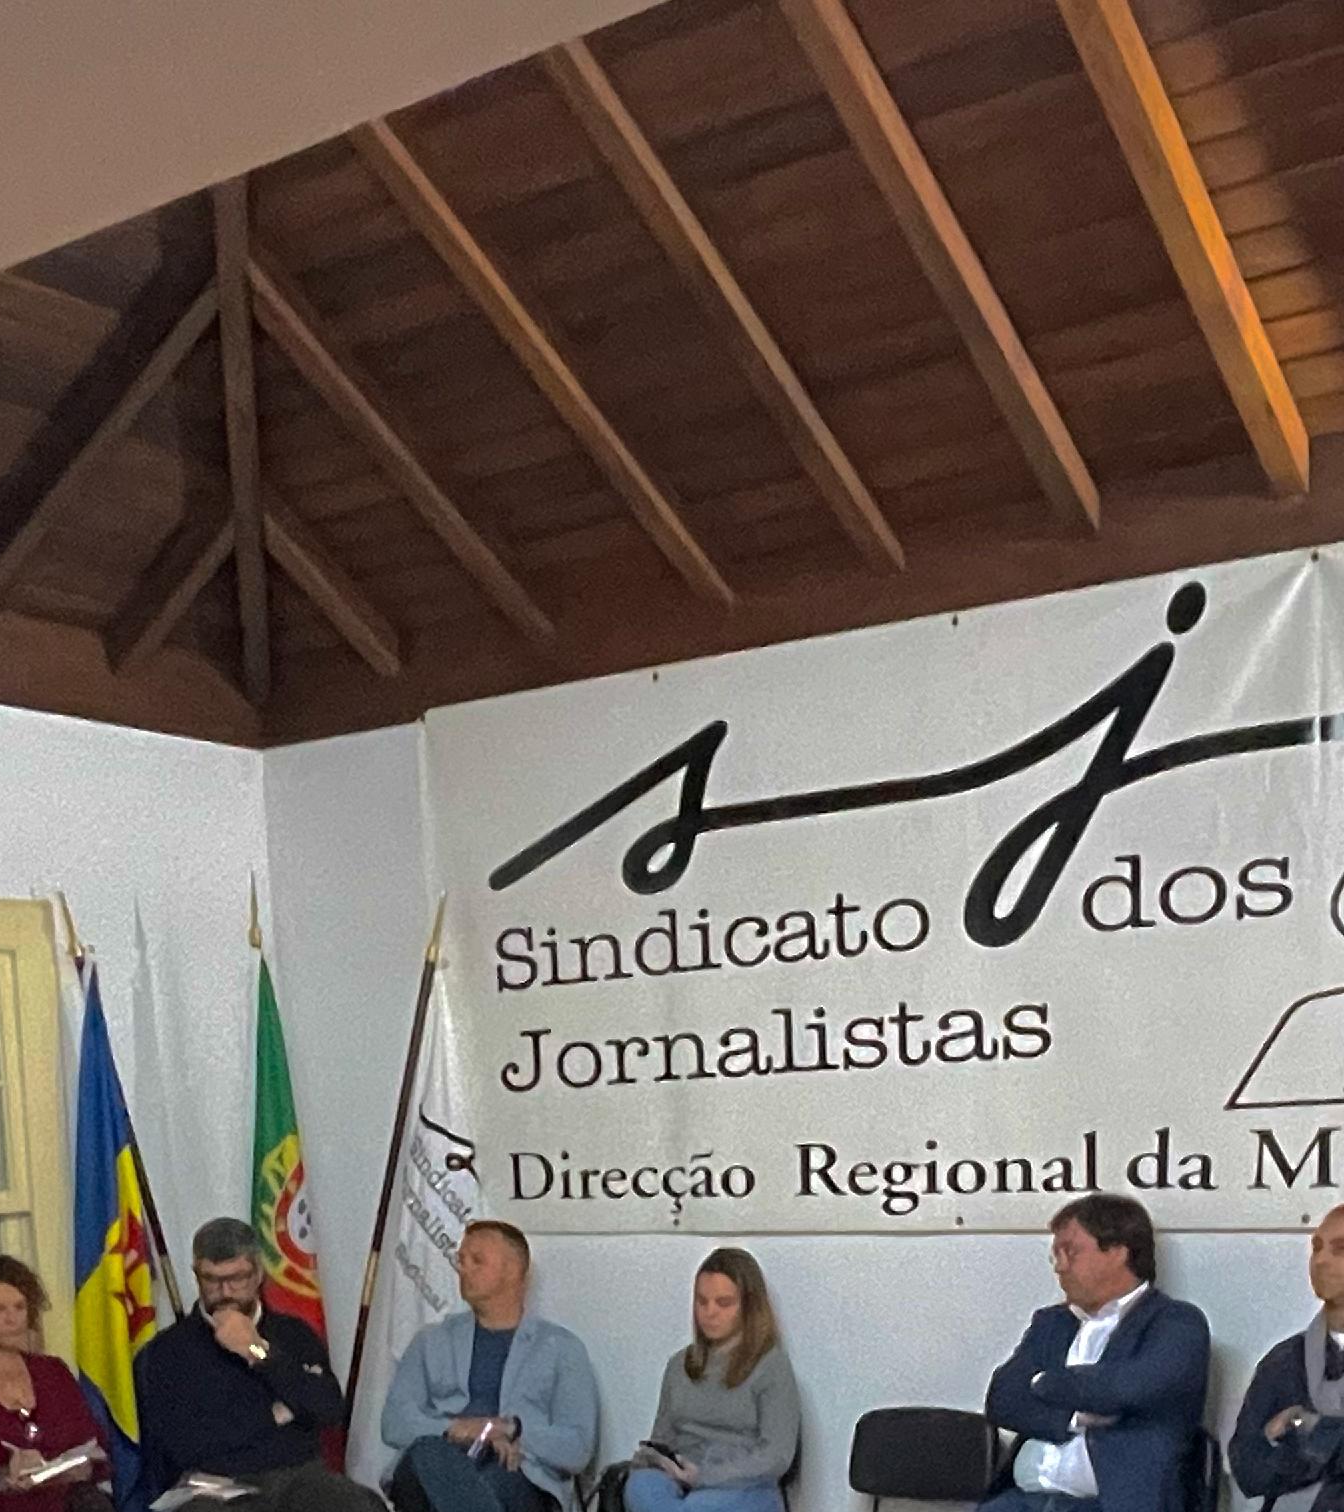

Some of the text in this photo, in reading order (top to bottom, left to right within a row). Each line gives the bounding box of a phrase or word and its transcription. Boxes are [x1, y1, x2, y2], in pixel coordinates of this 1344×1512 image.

[495, 854, 1294, 994] Sindicato dos
[500, 1001, 1053, 1094] Jornalistas
[508, 1150, 756, 1217] Direcção
[794, 1130, 1102, 1217] Regional
[1126, 1126, 1220, 1192] da
